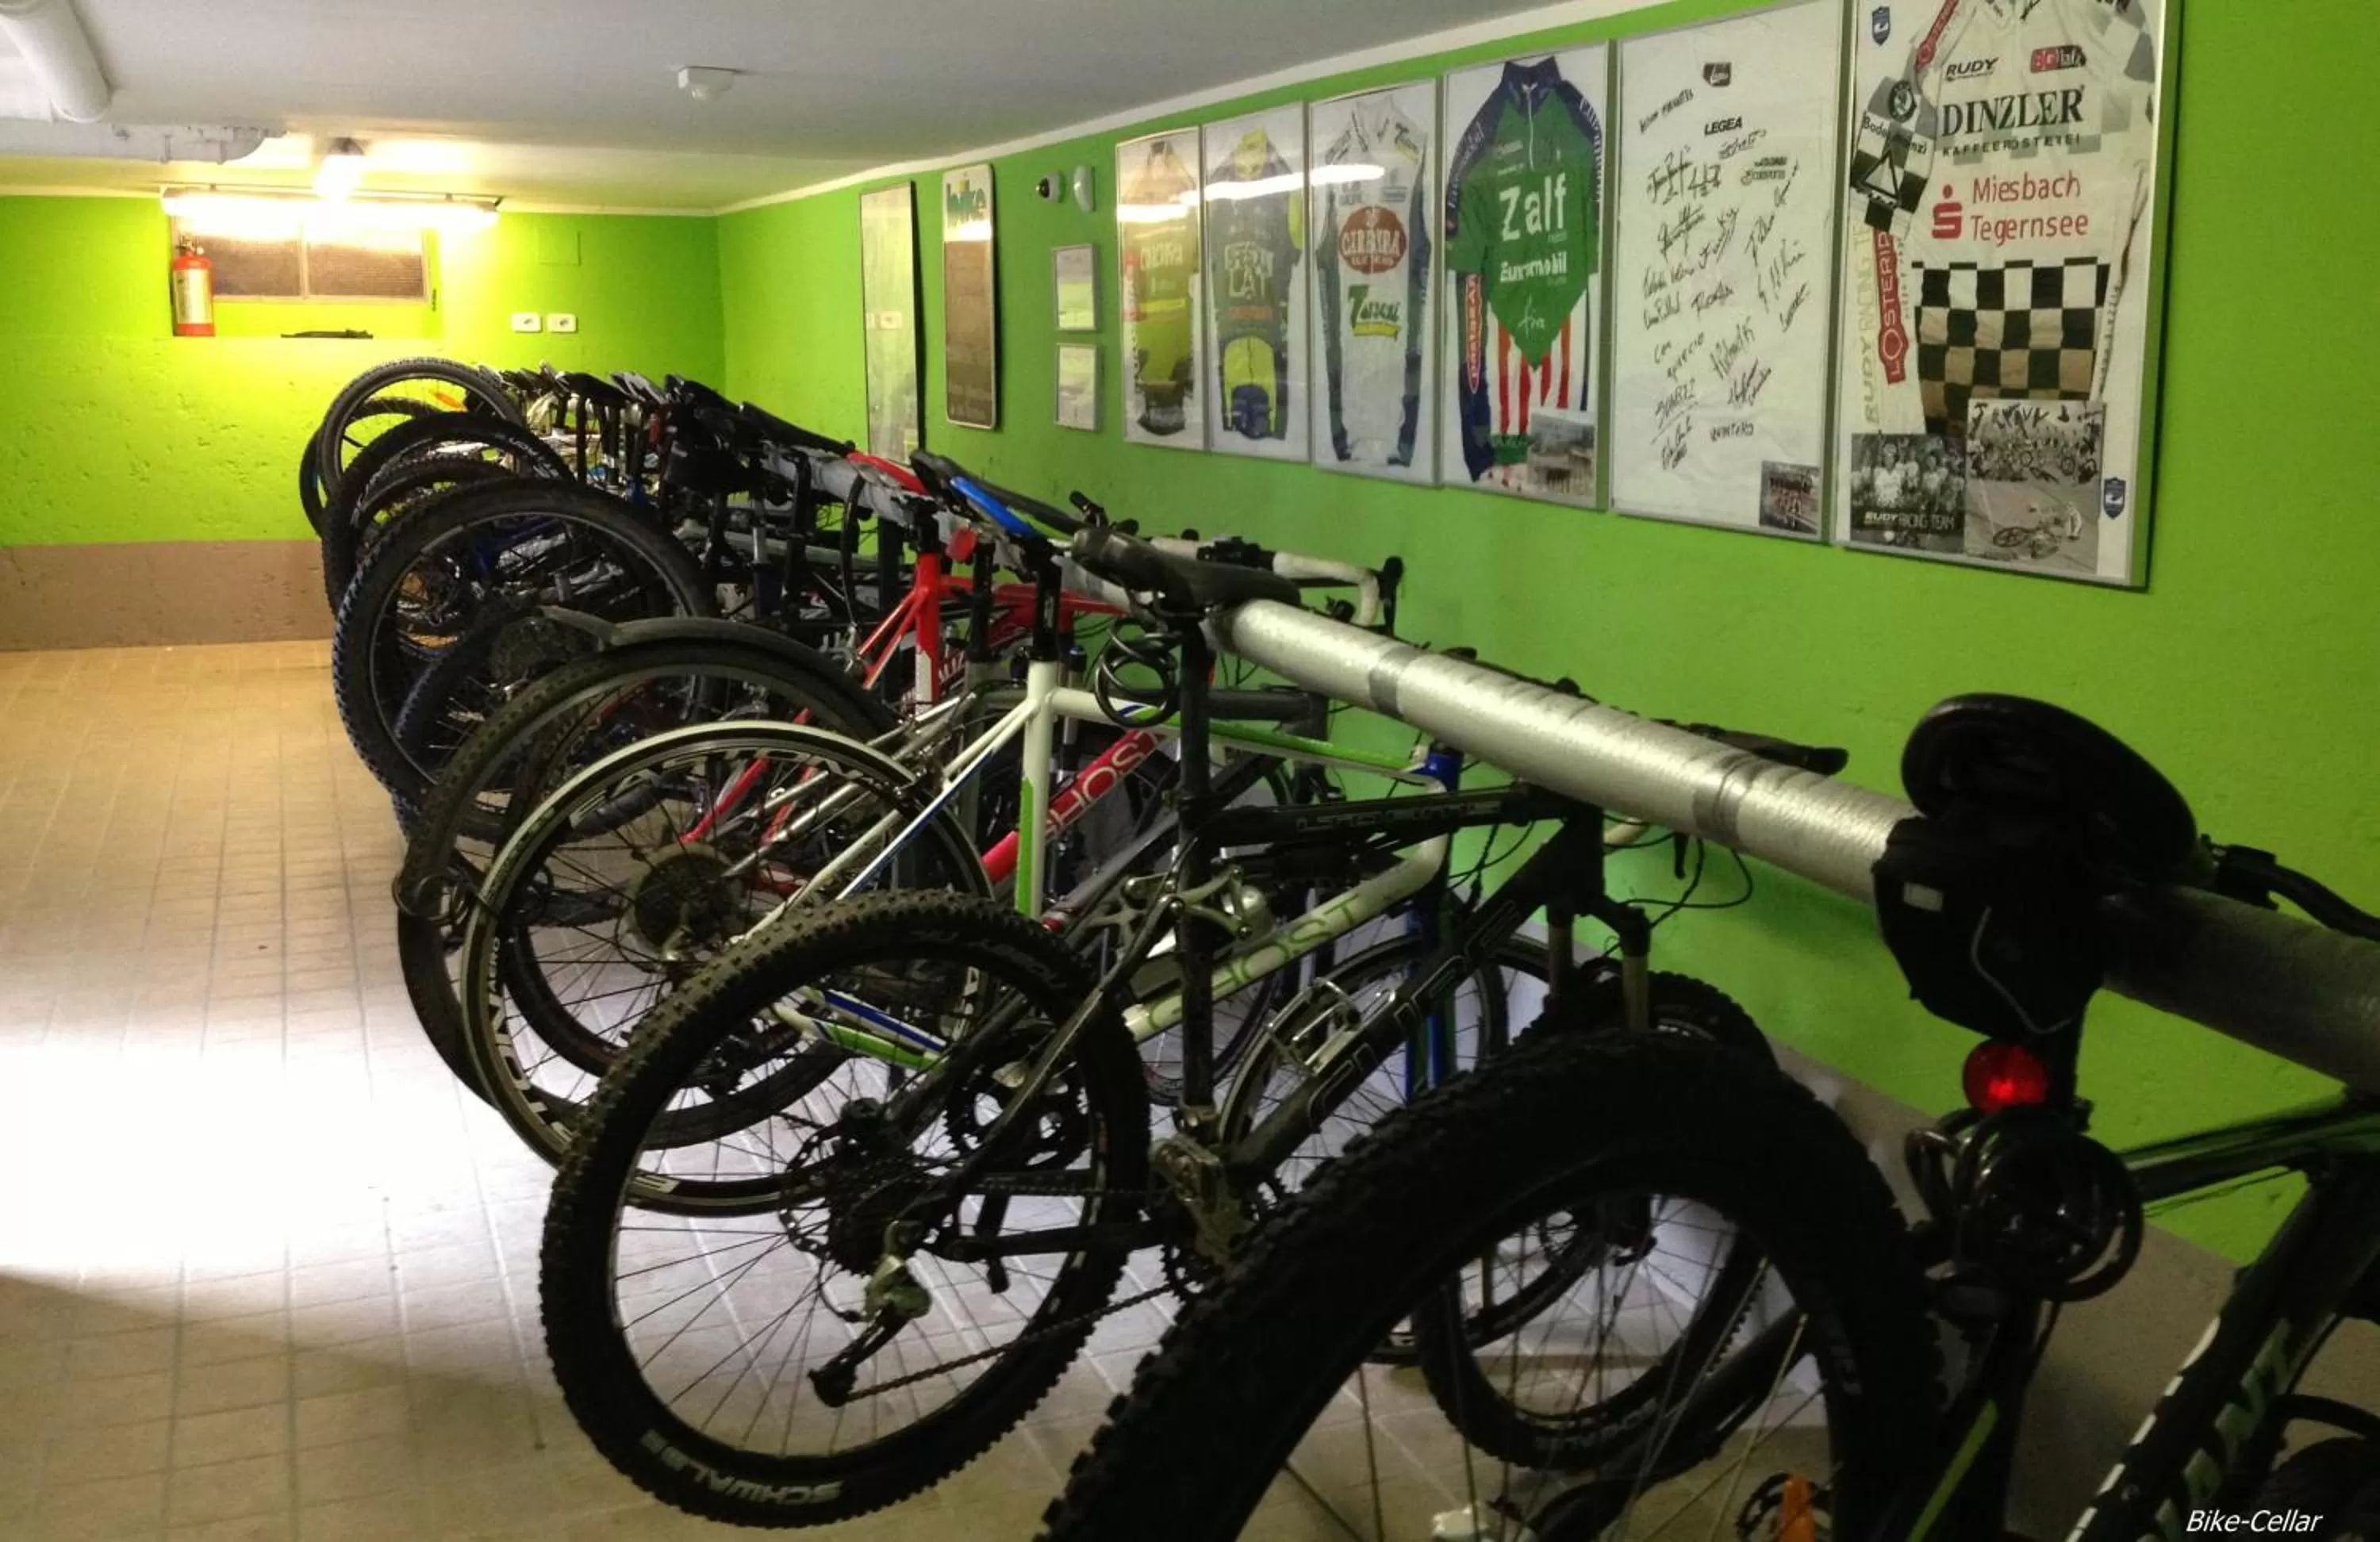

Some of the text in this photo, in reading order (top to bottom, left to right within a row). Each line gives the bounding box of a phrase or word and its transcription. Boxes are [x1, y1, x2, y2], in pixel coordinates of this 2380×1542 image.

[1946, 57, 1998, 78] RUDY
[1703, 115, 1744, 137] LEGEA
[1942, 88, 2083, 136] DINZLER
[1498, 172, 1568, 242] Zalf
[1972, 171, 2082, 205] Miesbach
[1971, 215, 2090, 247] Tegernsee
[1046, 731, 1159, 838] HOST
[639, 1429, 844, 1506] SCHWALBE
